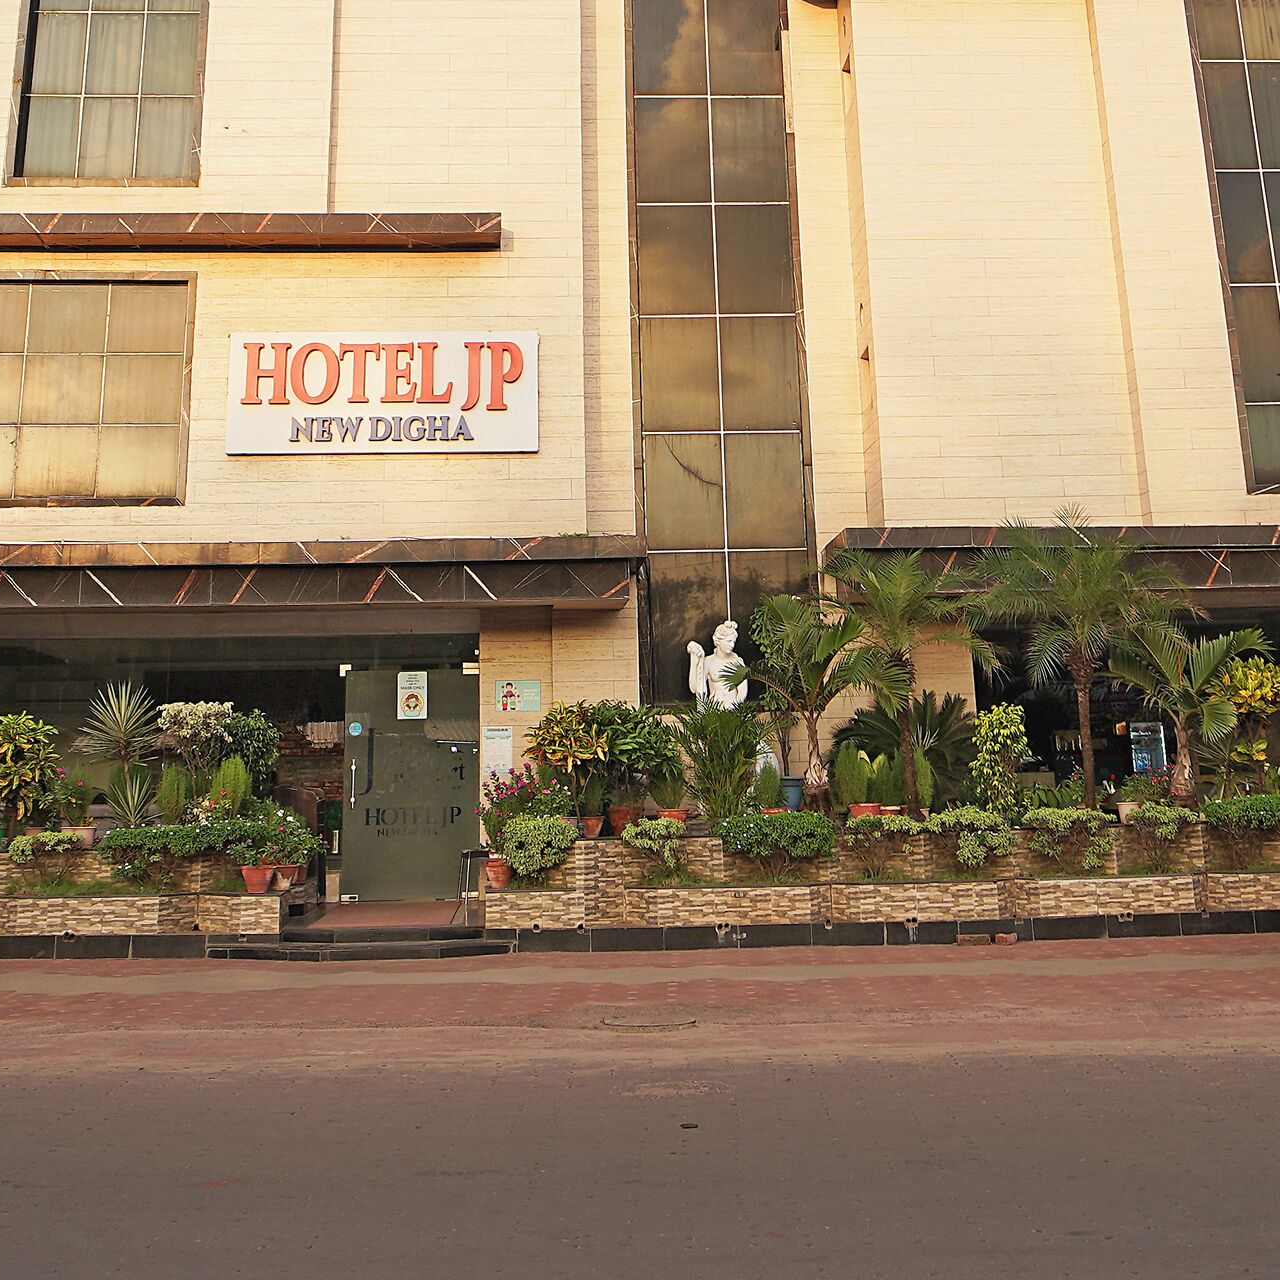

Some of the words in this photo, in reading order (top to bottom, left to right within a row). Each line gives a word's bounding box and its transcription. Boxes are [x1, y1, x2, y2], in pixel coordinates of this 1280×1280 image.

[240, 341, 453, 405] HOTEL
[460, 341, 524, 411] JP
[289, 416, 364, 443] NEW
[368, 415, 475, 442] DIGHA
